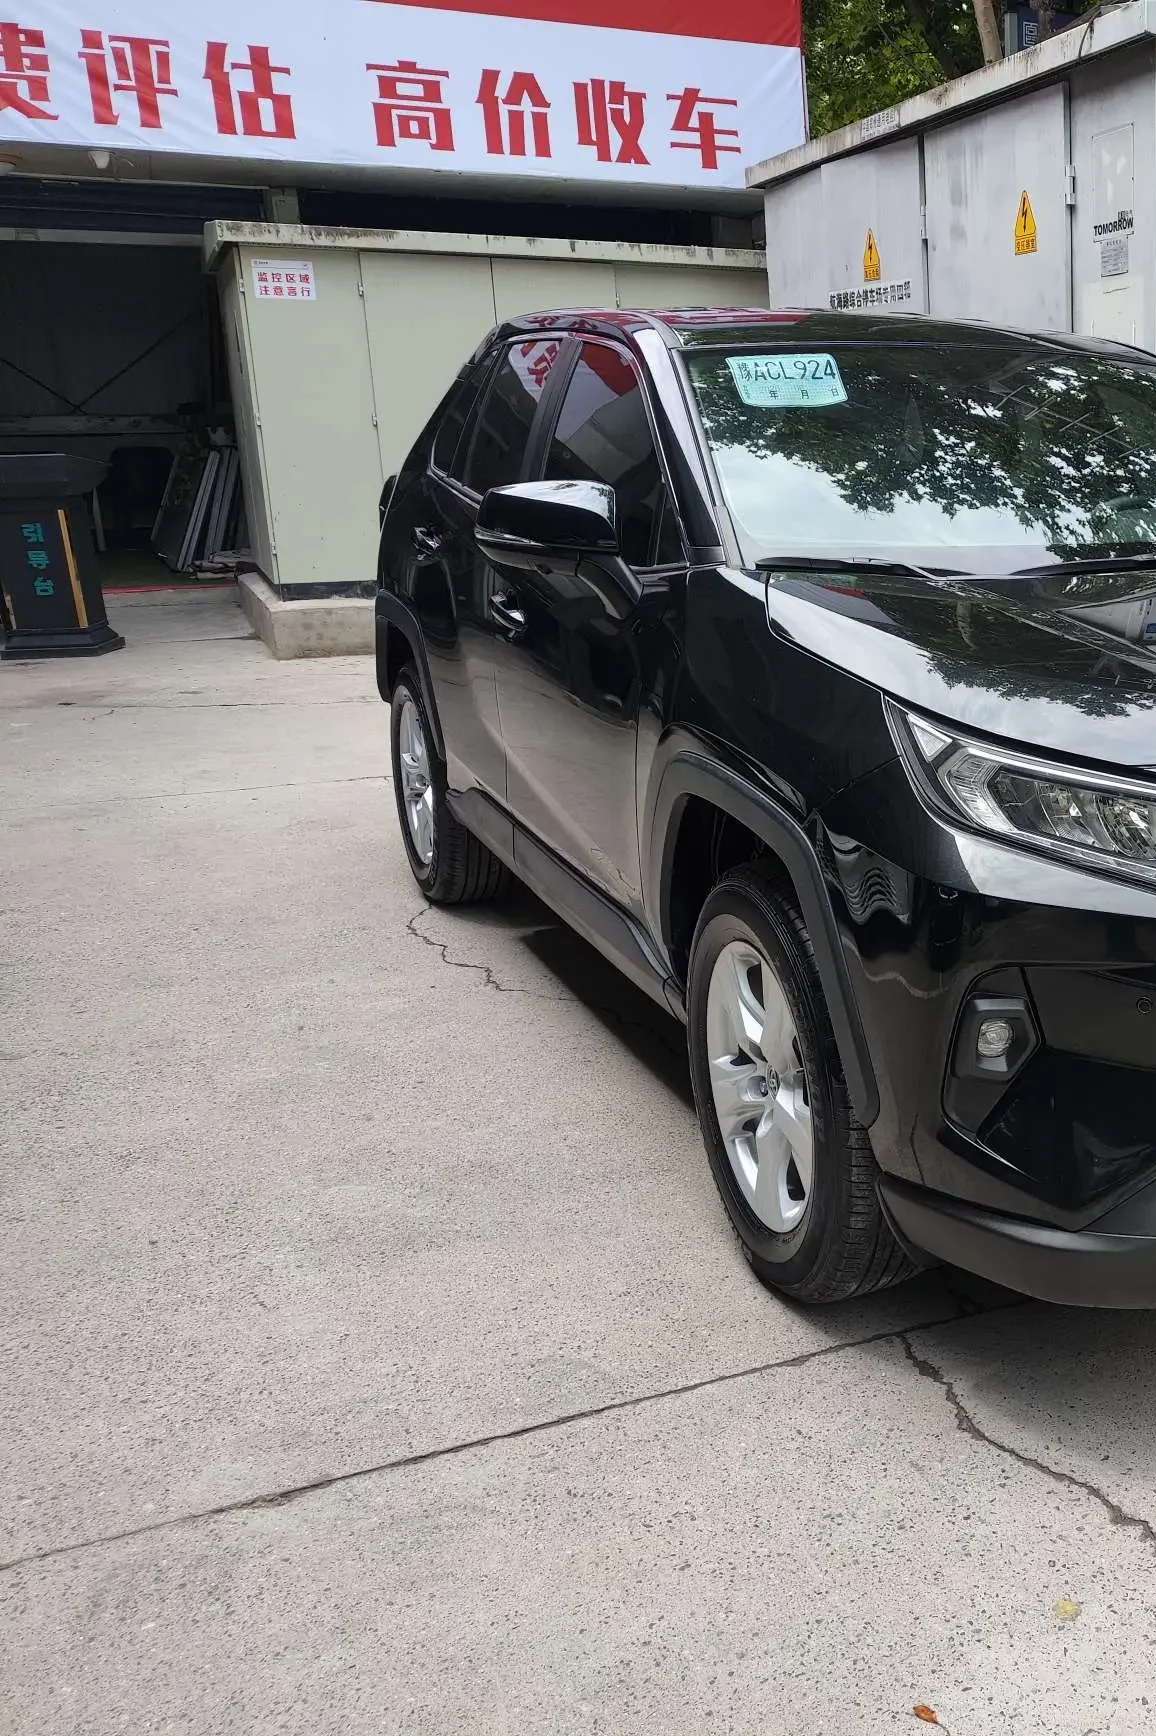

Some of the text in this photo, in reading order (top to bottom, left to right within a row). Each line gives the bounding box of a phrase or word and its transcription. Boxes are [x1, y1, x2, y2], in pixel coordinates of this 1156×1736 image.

[0, 22, 742, 170] 费评估 高价收车
[1094, 217, 1134, 237] TOMORROW
[258, 271, 310, 284] 监控区域
[259, 286, 310, 297] 注意言行
[769, 389, 839, 400] 年 月 日
